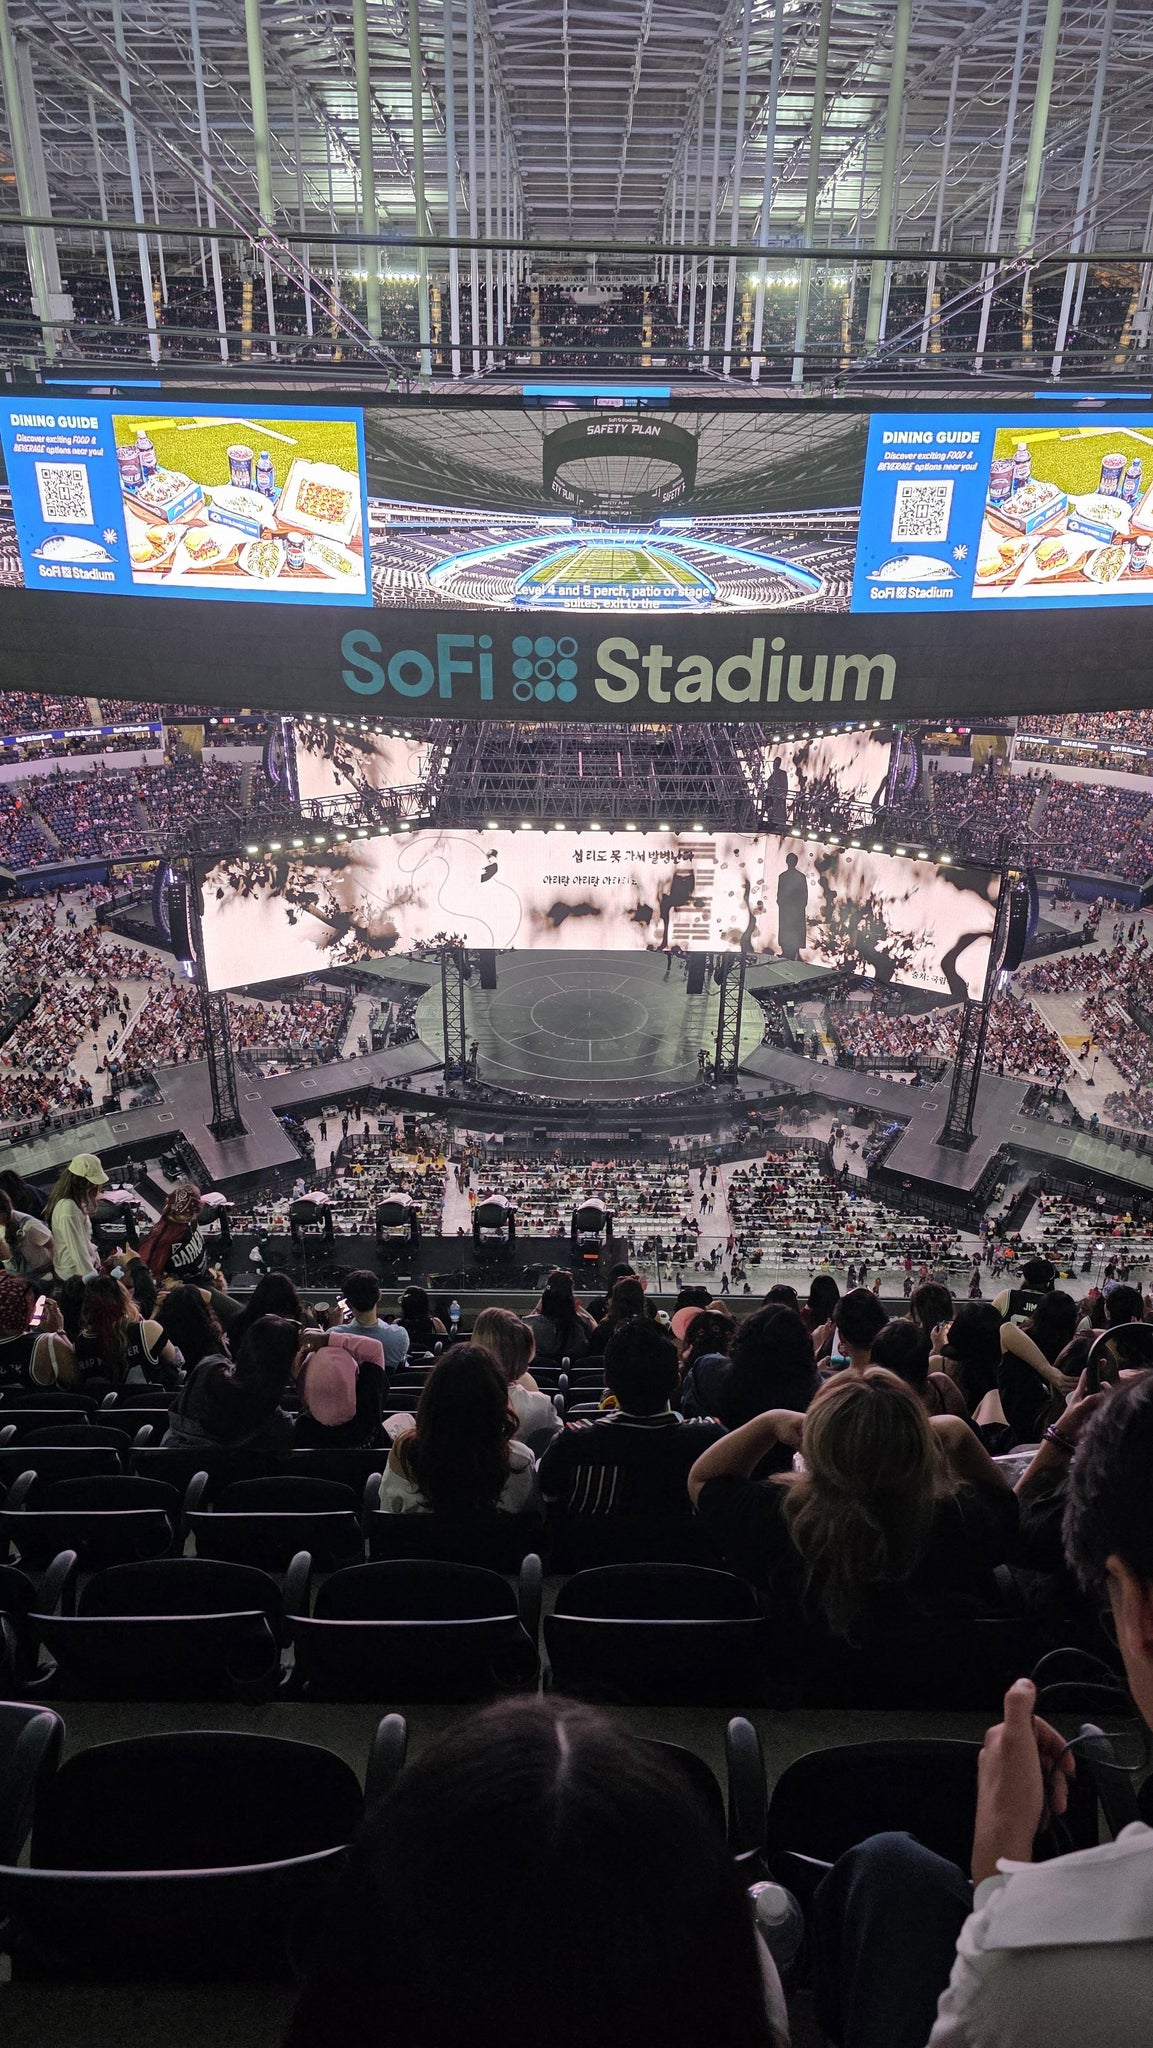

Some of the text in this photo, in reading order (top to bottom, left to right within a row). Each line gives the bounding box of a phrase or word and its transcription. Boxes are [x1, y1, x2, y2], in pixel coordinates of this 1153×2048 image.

[10, 413, 99, 429] DINING GUIDE
[586, 424, 661, 436] SAFETY PLAN
[16, 433, 45, 443] Discover
[72, 435, 90, 445] FOOD
[882, 431, 981, 444] DINING GUIDE
[13, 443, 46, 454] BEVERAGE
[46, 445, 71, 456] options
[71, 447, 88, 456] near
[884, 451, 917, 461] Discover
[917, 451, 946, 462] exciting
[946, 450, 967, 460] FOOD
[877, 462, 915, 472] BEVERAGE
[914, 462, 943, 473] options
[942, 463, 961, 472] near
[551, 481, 561, 495] ETY
[662, 485, 681, 503] SAFETY
[38, 564, 116, 582] SoFi Stadium
[515, 585, 711, 599] Level 4 and 5 perch, patio or stage
[870, 585, 954, 600] SoFi Stadium
[563, 598, 661, 609] suites, exit to the
[339, 628, 898, 704] SoFi Stadium
[542, 875, 570, 887] 아리랑
[572, 875, 600, 888] 아리랑
[1022, 1302, 1038, 1312] JIM
